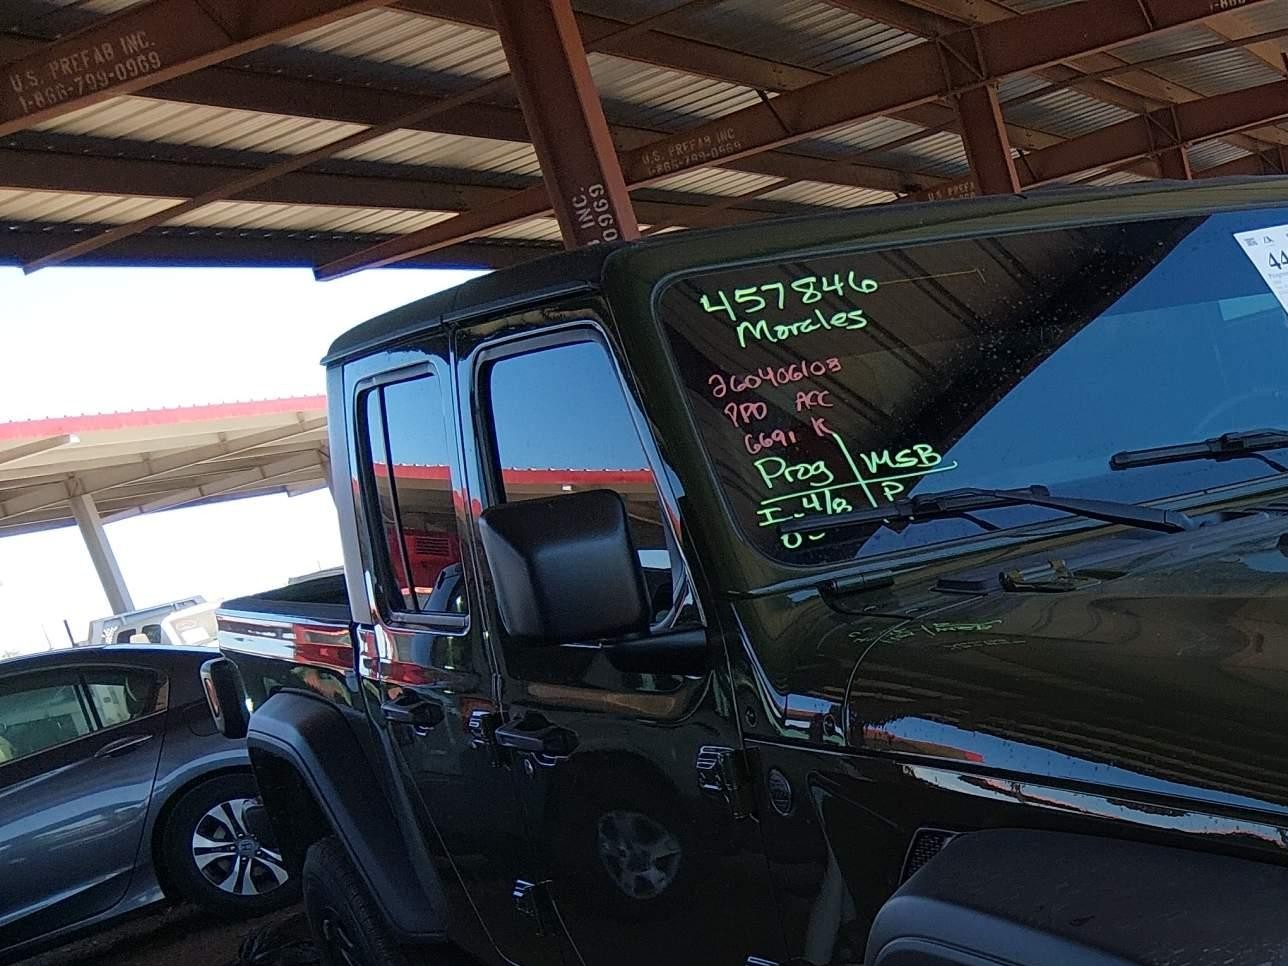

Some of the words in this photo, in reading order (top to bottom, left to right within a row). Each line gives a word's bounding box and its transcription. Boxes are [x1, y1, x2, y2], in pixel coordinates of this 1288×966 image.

[9, 71, 44, 93] U.S.
[49, 43, 114, 79] PREFAB
[120, 31, 155, 55] INC.
[700, 271, 879, 321] 457846
[736, 308, 867, 348] Morales
[755, 457, 835, 489] Prog
[860, 444, 942, 473] MSB
